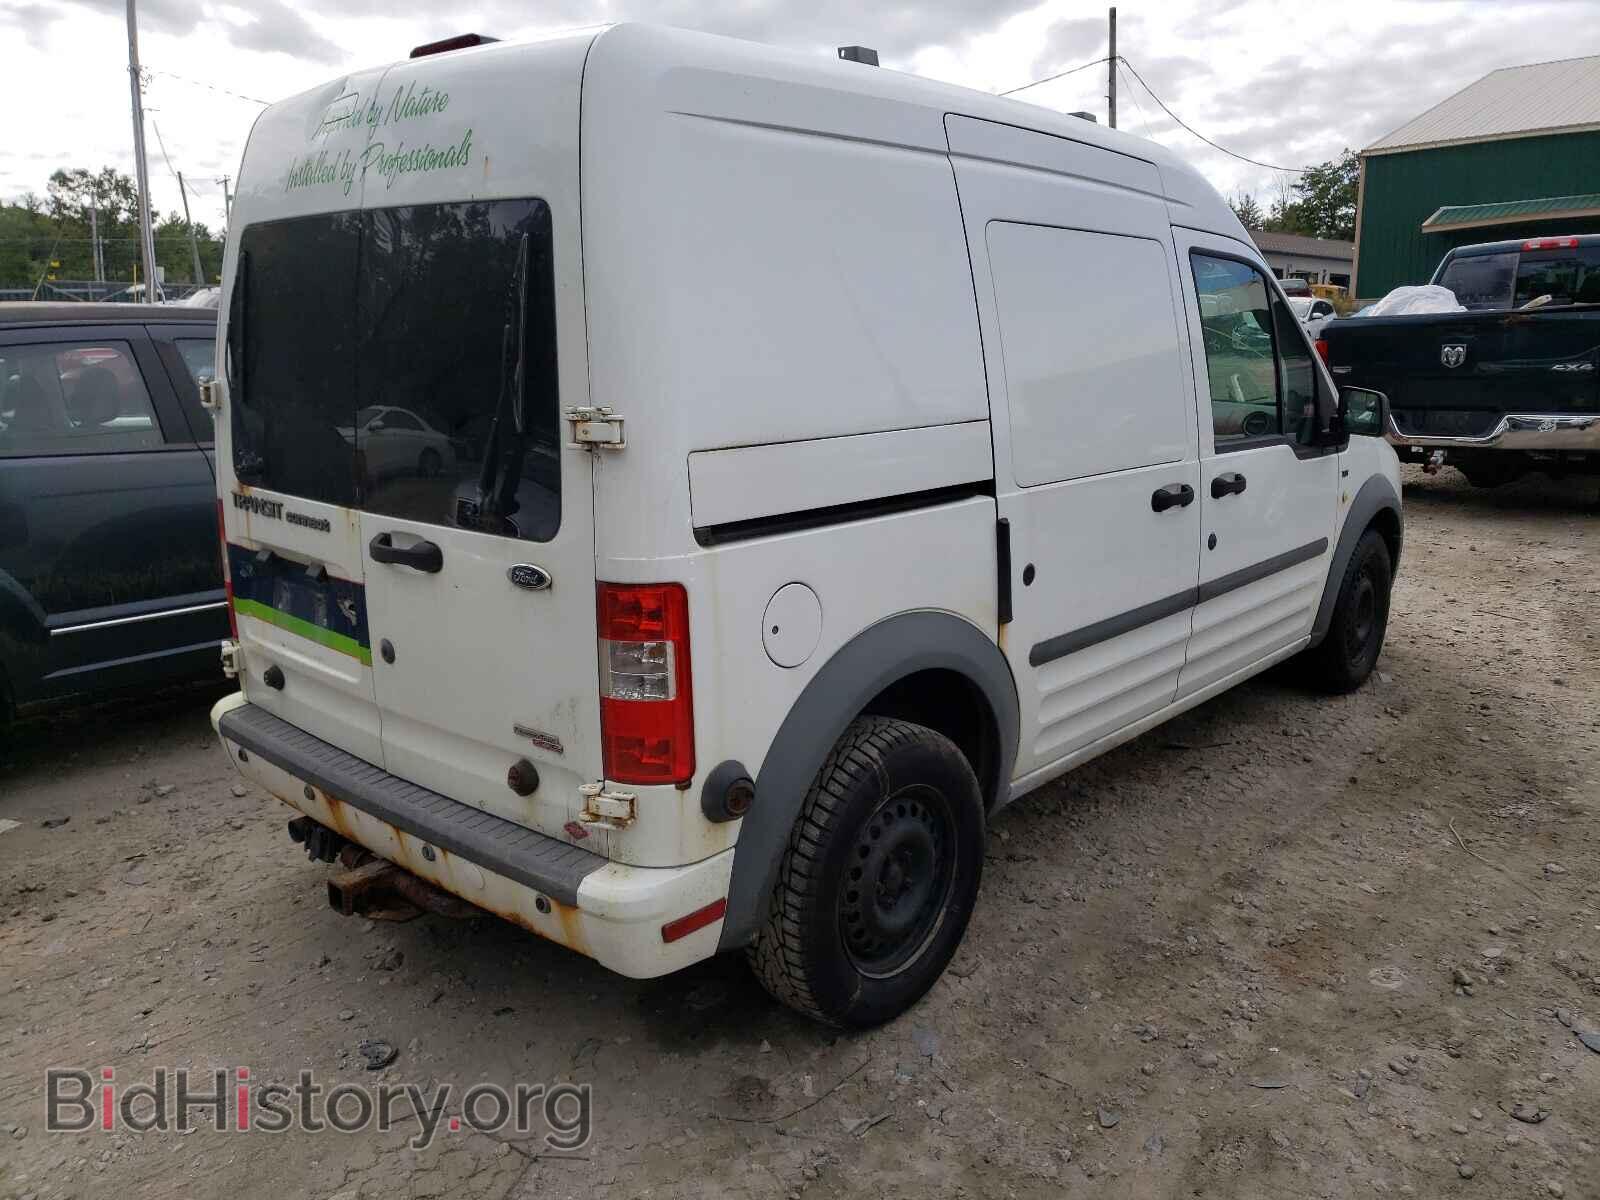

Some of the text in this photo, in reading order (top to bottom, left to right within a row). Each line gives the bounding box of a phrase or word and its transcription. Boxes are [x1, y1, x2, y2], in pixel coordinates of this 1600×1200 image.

[383, 80, 449, 126] Nature
[286, 128, 473, 197] Installed by Professionals
[233, 493, 284, 520] TRANSIT
